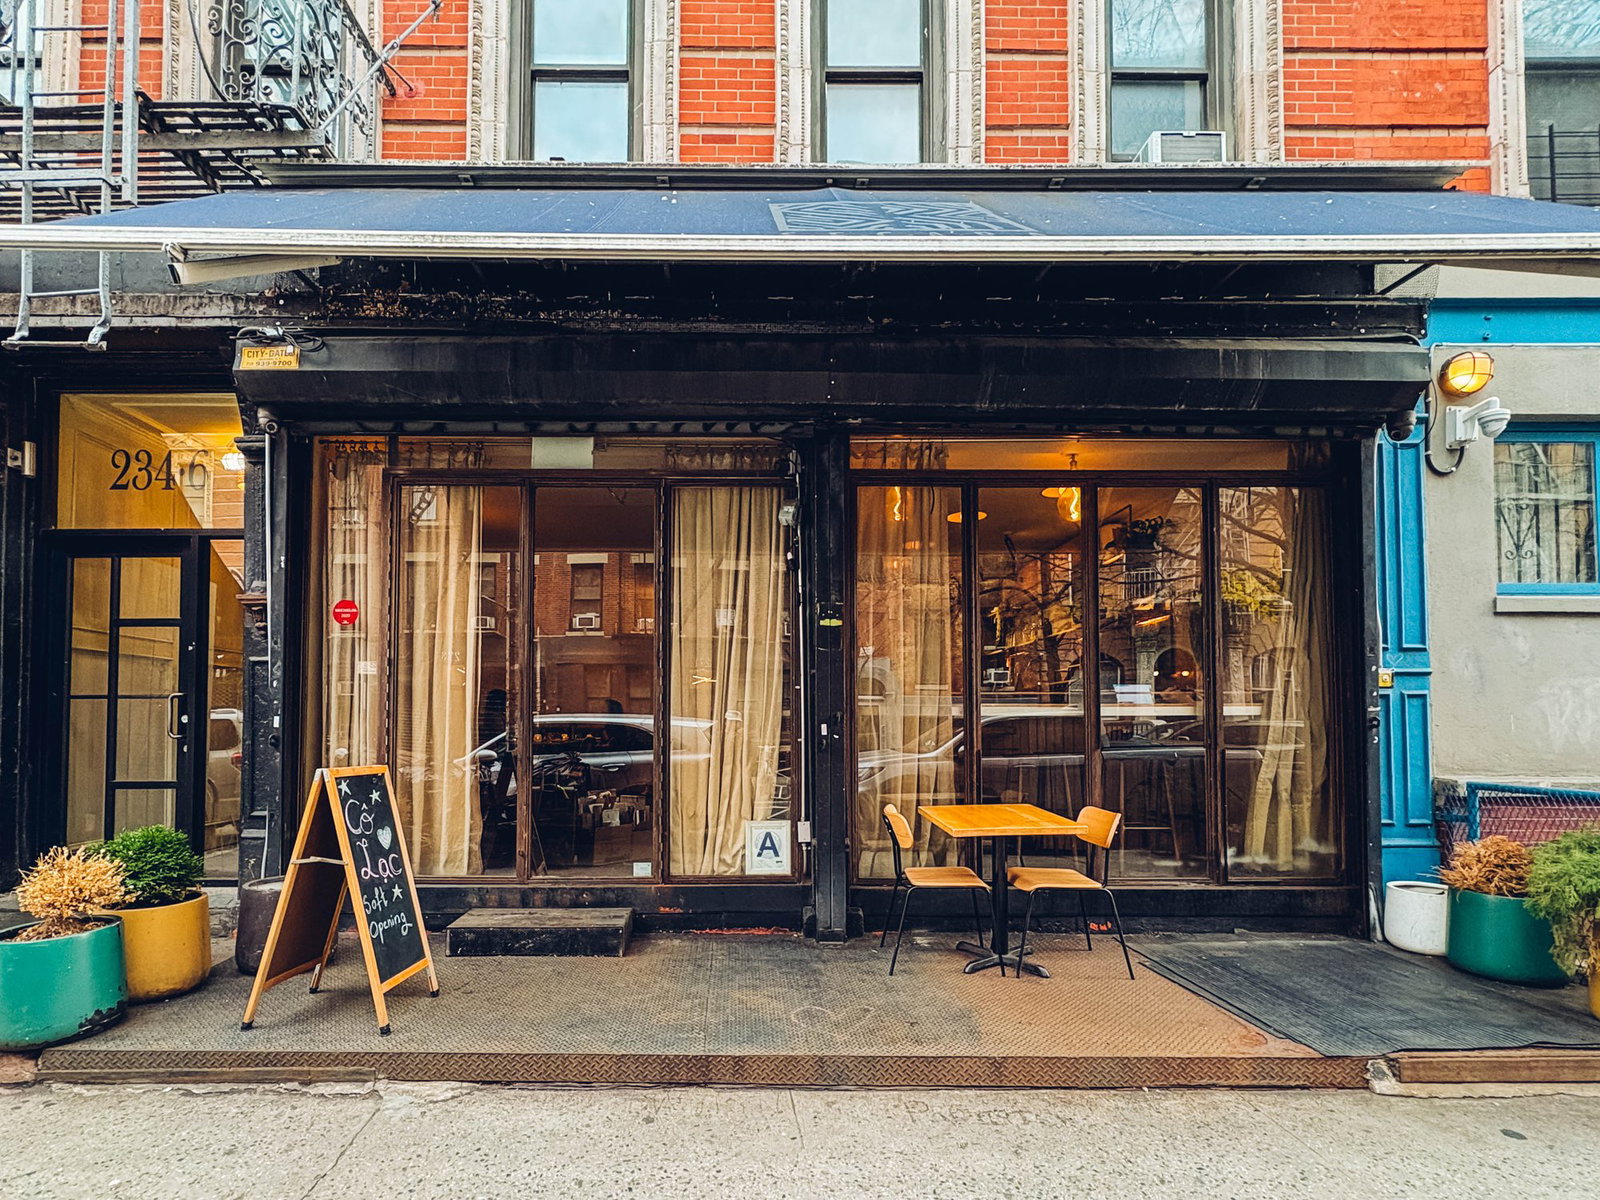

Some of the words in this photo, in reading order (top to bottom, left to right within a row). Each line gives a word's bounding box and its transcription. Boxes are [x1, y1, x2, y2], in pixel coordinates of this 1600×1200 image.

[345, 799, 374, 835] Cô
[756, 831, 780, 858] A
[362, 886, 388, 915] Soft
[369, 911, 413, 945] Opening
